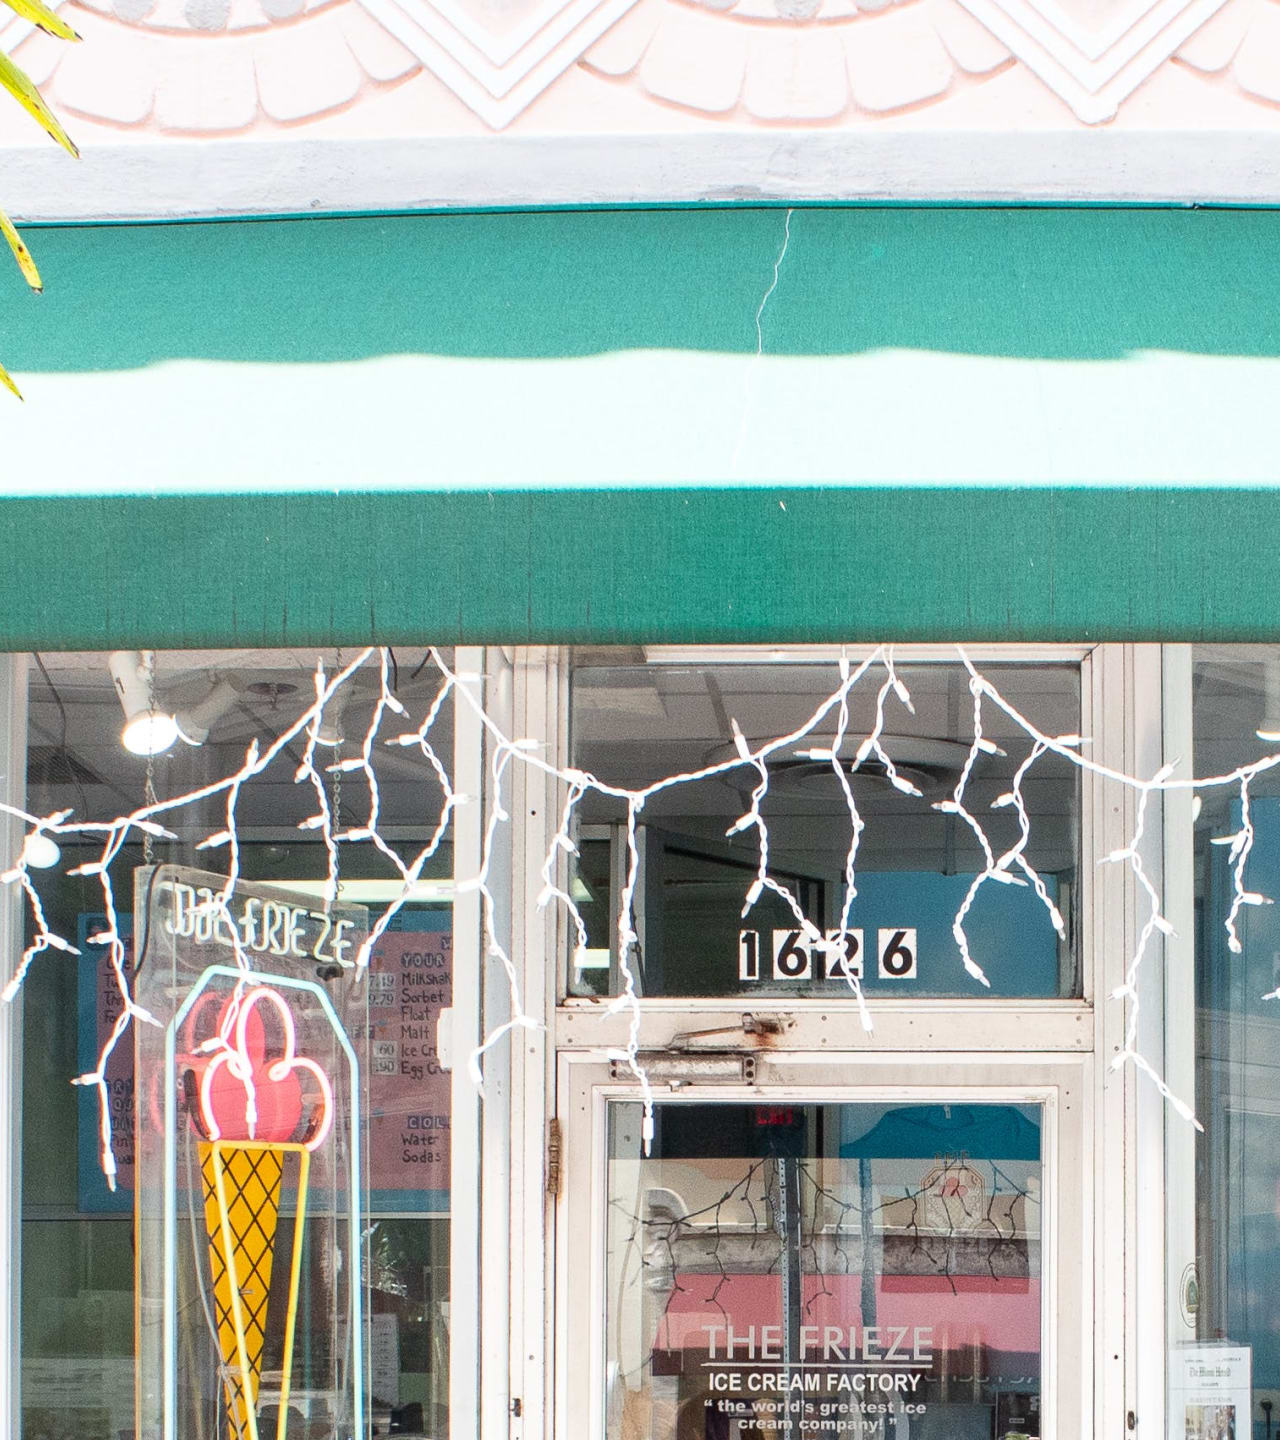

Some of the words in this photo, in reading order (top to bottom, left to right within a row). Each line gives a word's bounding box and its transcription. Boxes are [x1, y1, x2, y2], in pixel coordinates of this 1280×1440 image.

[401, 952, 445, 967] YOUR
[740, 930, 914, 978] 1626
[401, 971, 452, 986] Milkshak
[401, 988, 445, 1004] Sorbet
[401, 1026, 430, 1040] Malt
[407, 1116, 451, 1129] COL
[402, 1149, 441, 1163] Sodas
[701, 1324, 781, 1360] THE
[798, 1326, 933, 1361] FRIEZE
[708, 1373, 742, 1391] ICE
[747, 1374, 821, 1391] CREAM
[826, 1374, 921, 1391] FACTORY
[717, 1399, 749, 1414] the
[819, 1401, 895, 1417] greatest
[899, 1402, 927, 1414] ice
[737, 1420, 794, 1431] cream
[798, 1417, 885, 1433] company!
